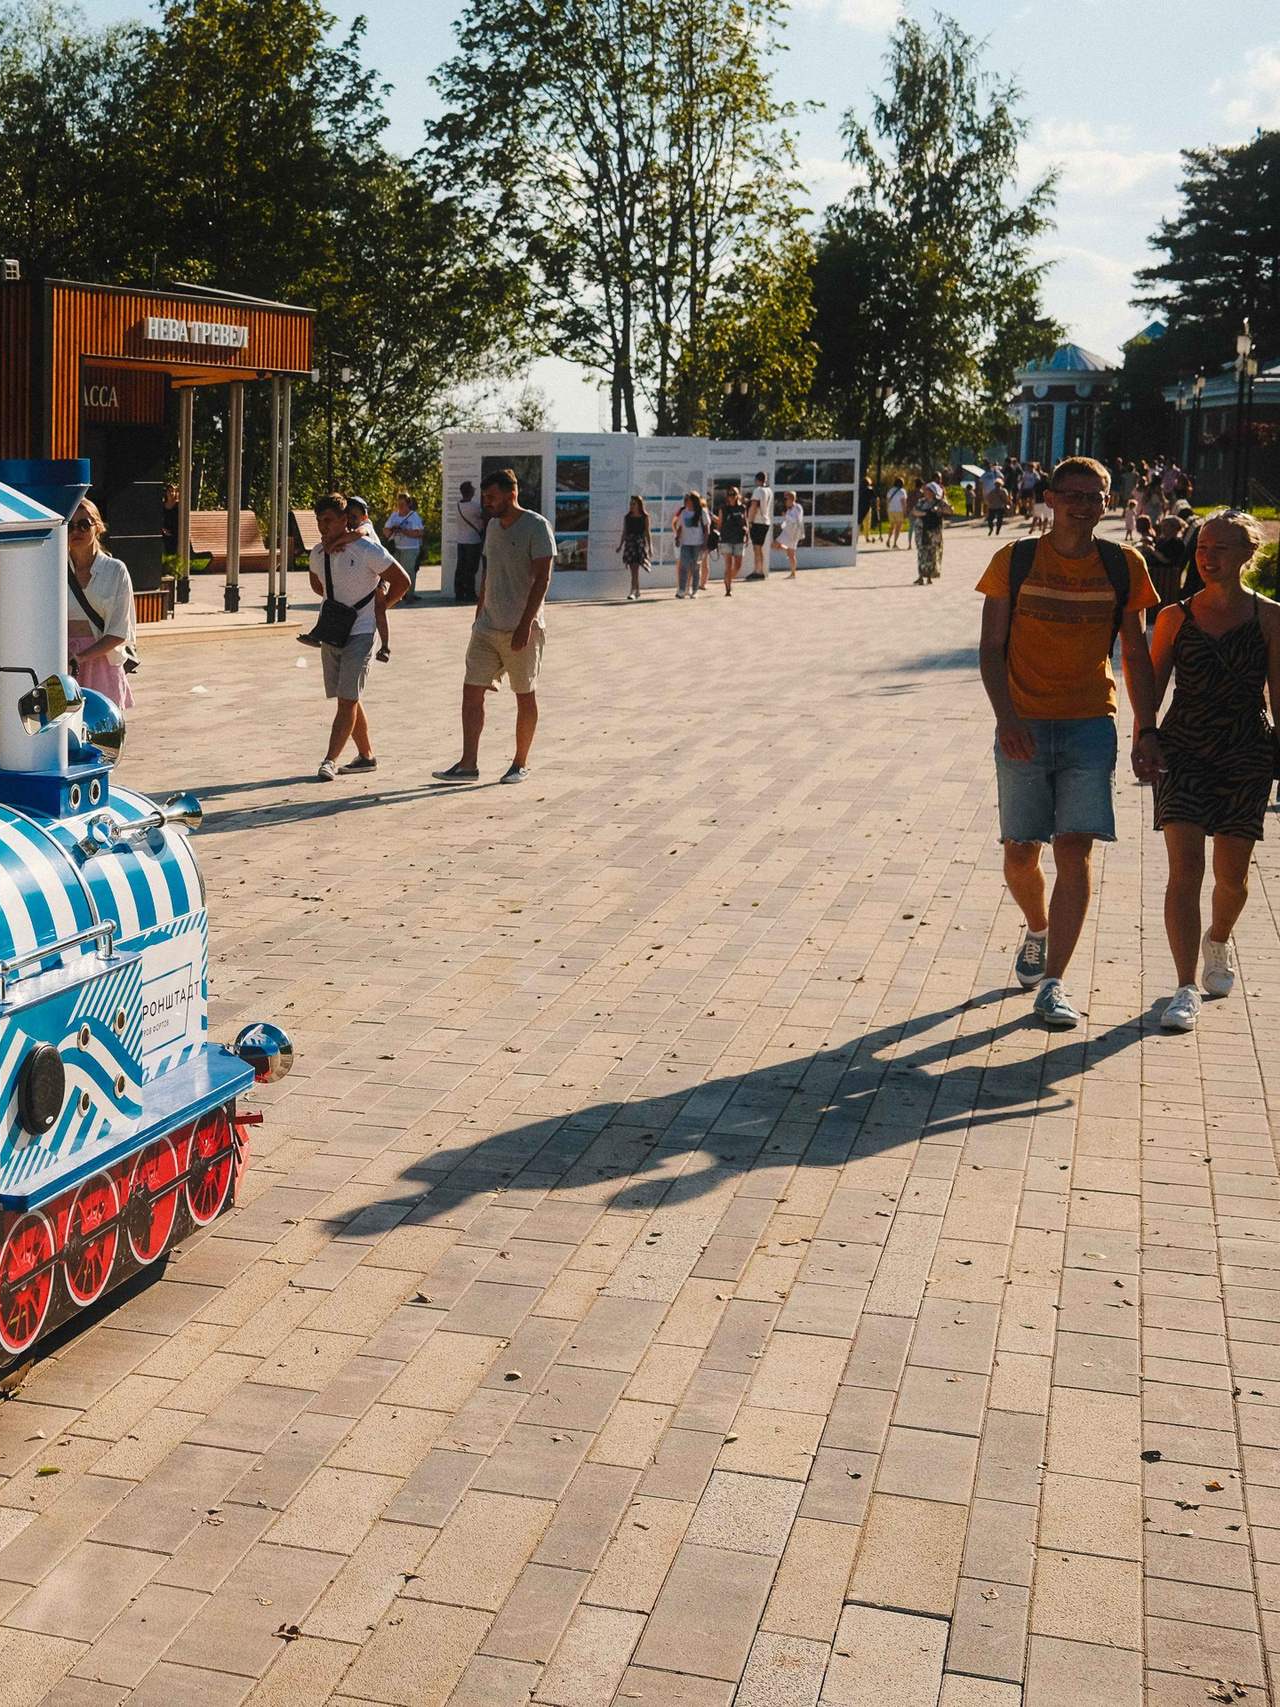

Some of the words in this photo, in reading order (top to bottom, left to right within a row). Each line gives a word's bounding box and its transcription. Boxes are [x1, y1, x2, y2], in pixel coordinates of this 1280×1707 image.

[146, 317, 189, 342] НЕВА
[190, 321, 249, 348] ТРЕВЕЛ
[142, 981, 200, 1020] РОНШТАДТ
